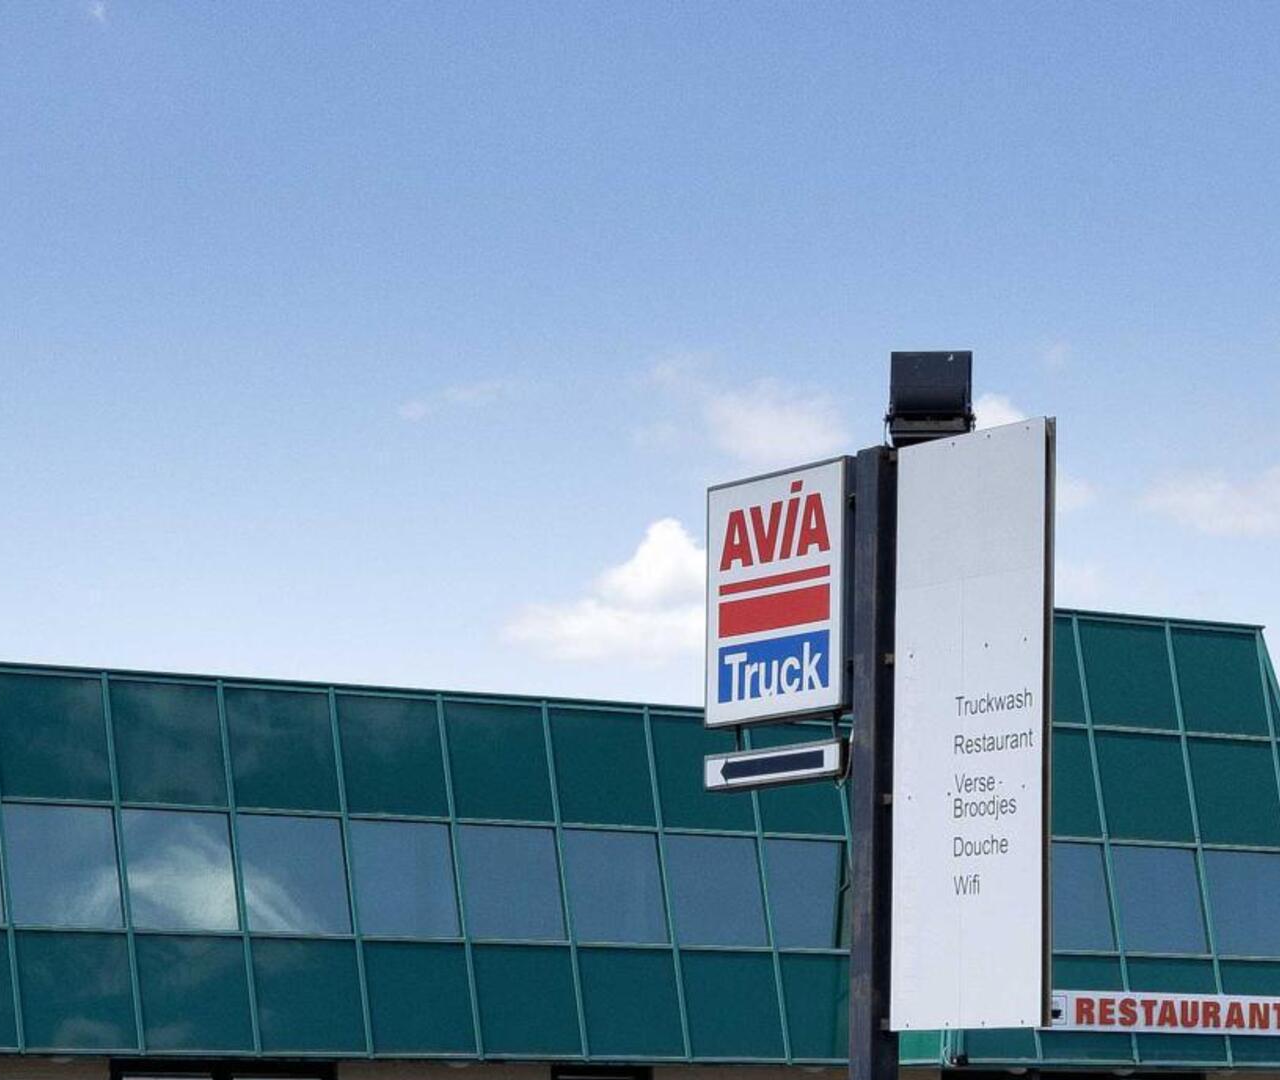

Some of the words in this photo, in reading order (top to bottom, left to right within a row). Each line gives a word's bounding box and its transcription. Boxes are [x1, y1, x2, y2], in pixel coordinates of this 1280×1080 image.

[724, 642, 826, 701] Truck
[955, 688, 1033, 716] Truckwash
[954, 728, 1034, 755] Restaurant
[954, 795, 1017, 820] Broodjes
[954, 834, 1009, 857] Douche
[954, 874, 981, 895] Wifi
